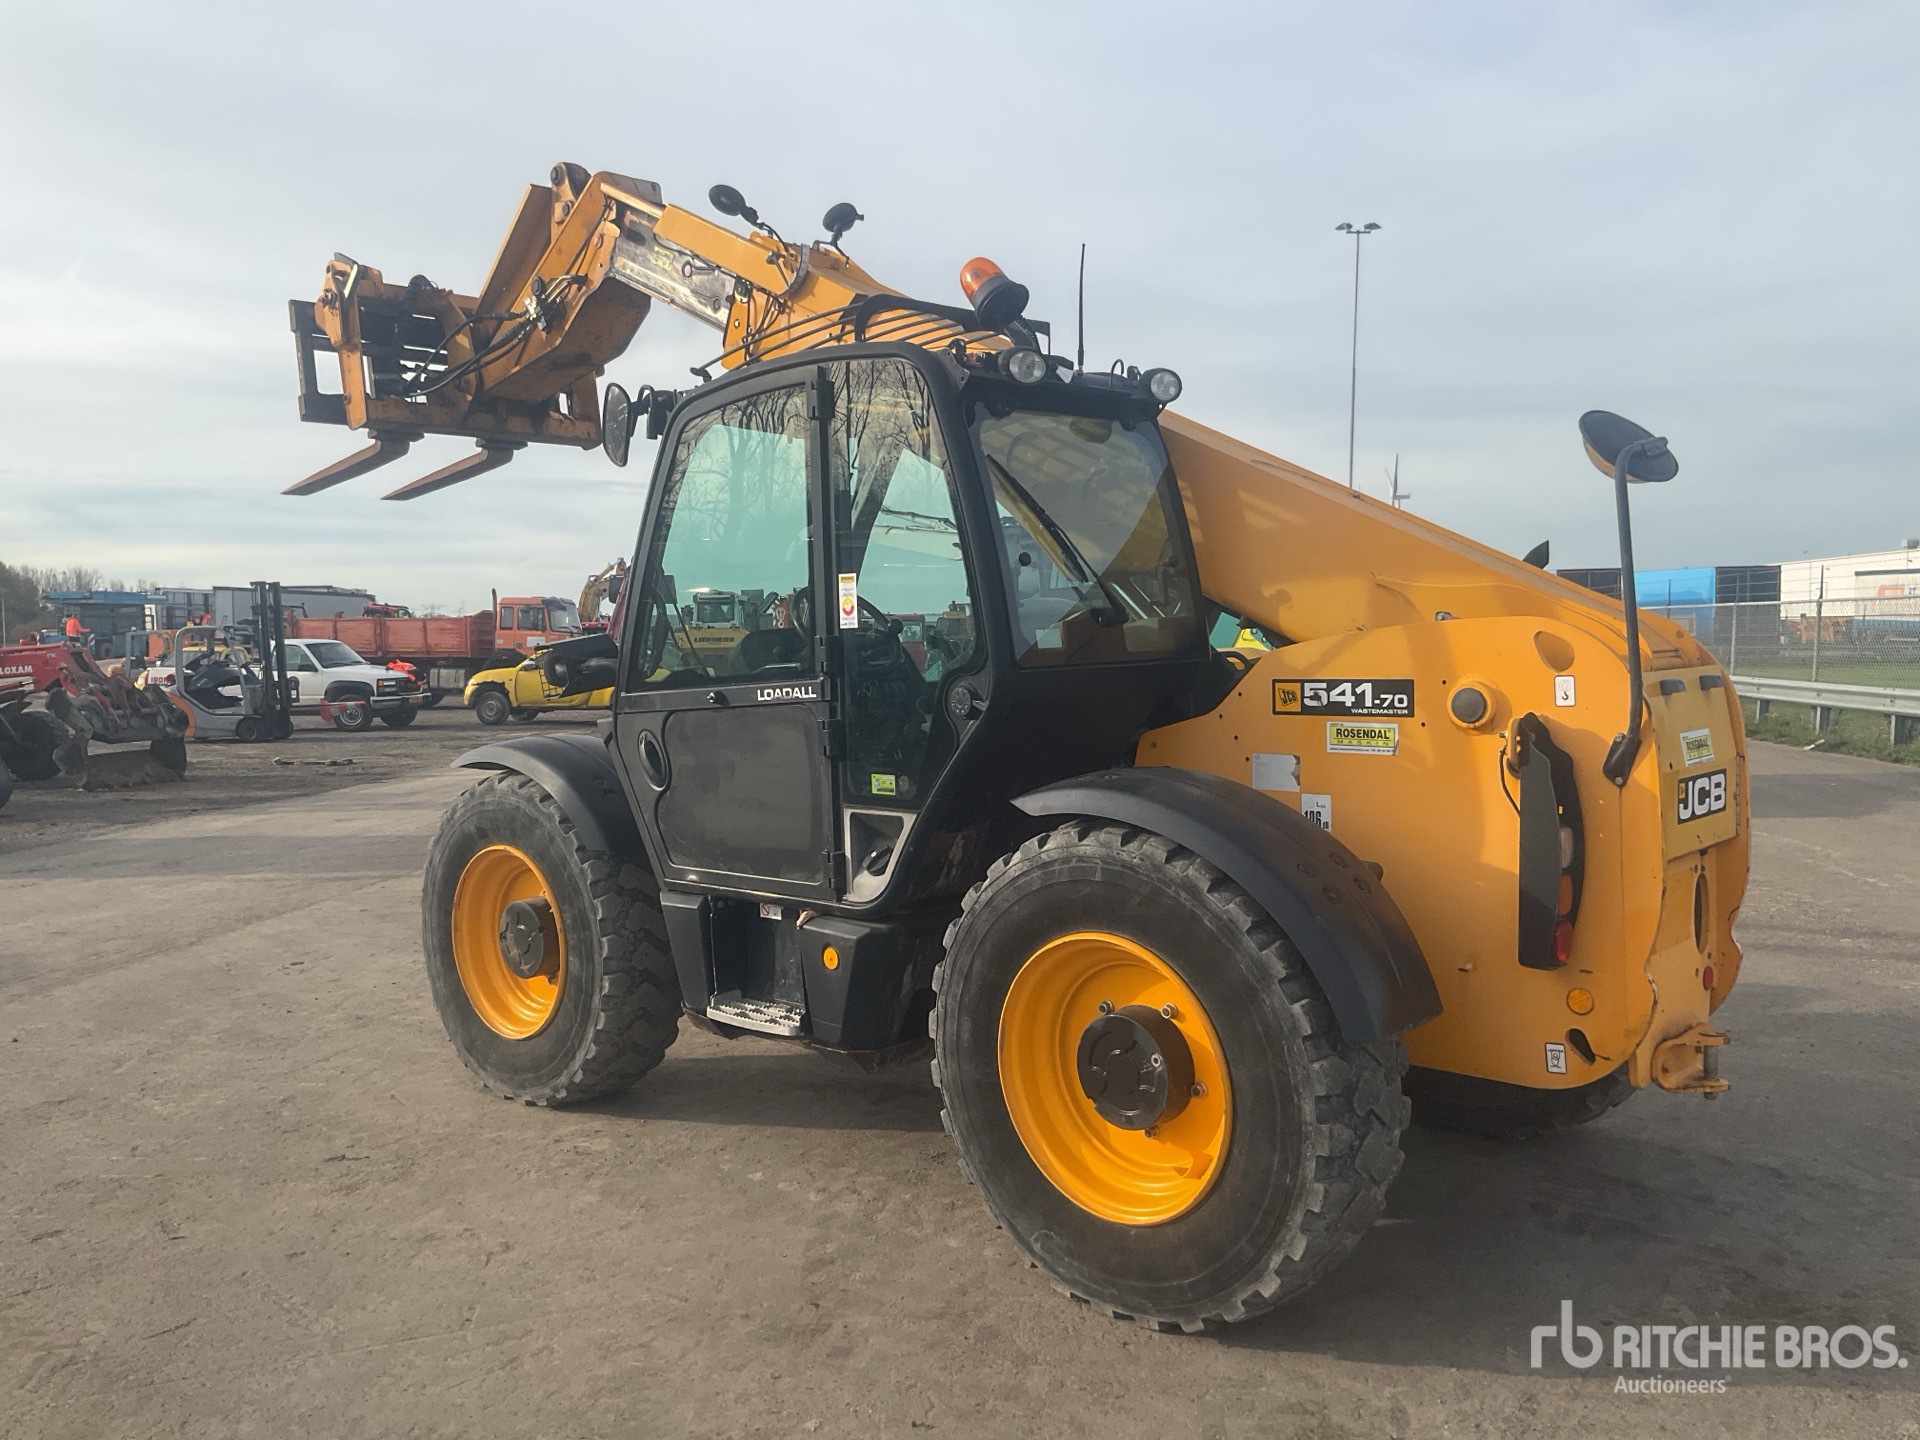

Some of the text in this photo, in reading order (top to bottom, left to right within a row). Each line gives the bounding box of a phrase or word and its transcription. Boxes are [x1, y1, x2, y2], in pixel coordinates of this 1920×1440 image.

[0, 665, 32, 674] LOXAM
[757, 687, 816, 700] LOADALL
[1303, 682, 1408, 708] 541-70
[1336, 728, 1390, 740] ROSENDAL
[1679, 774, 1725, 820] JCB
